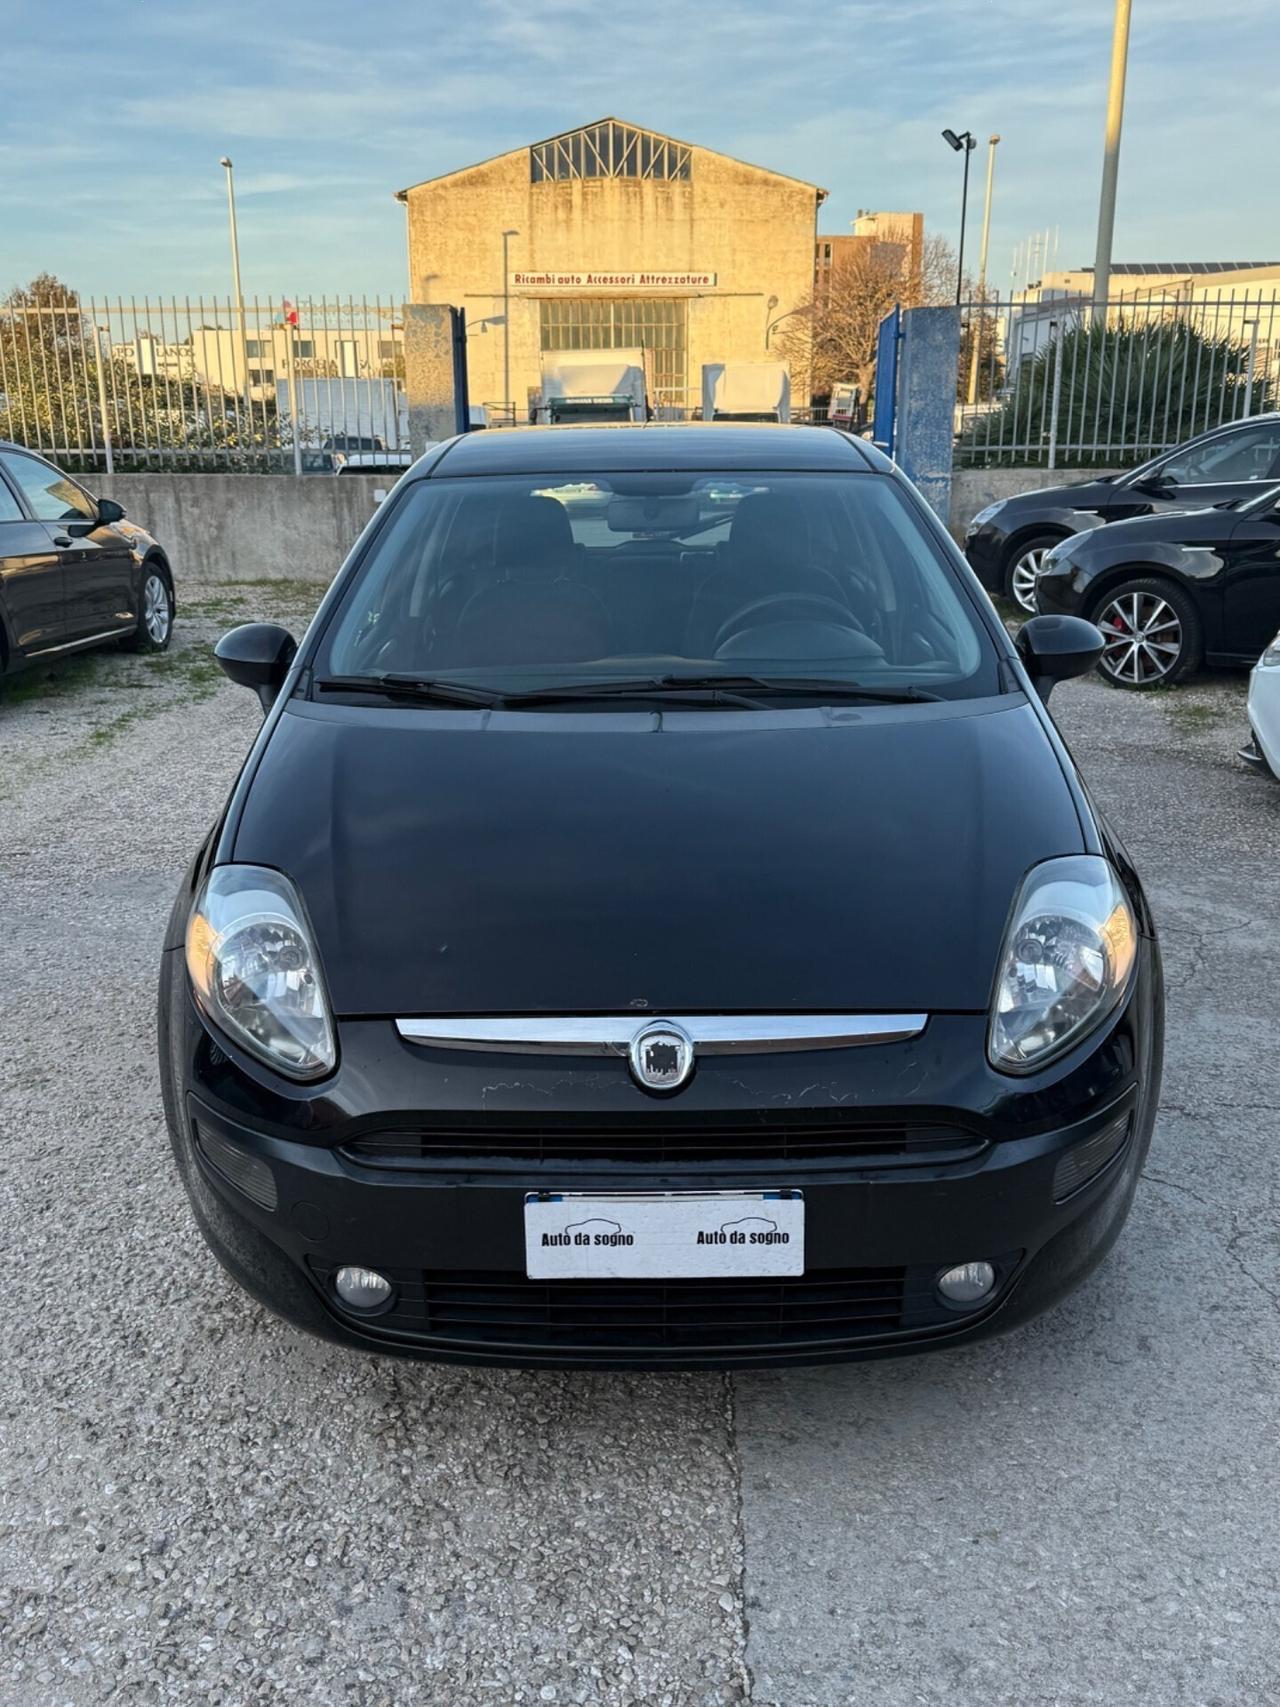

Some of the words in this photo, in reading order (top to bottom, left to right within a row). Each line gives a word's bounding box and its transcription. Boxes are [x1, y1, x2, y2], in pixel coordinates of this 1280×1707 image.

[514, 273, 556, 285] Ricambi
[557, 274, 582, 285] auto
[586, 273, 636, 285] Accessori
[639, 273, 710, 285] Attrezzature
[541, 1232, 571, 1247] Auto
[574, 1232, 591, 1246] da
[593, 1234, 635, 1247] sogno
[696, 1230, 726, 1245] Auto
[729, 1230, 746, 1245] da
[749, 1232, 790, 1246] sogno
